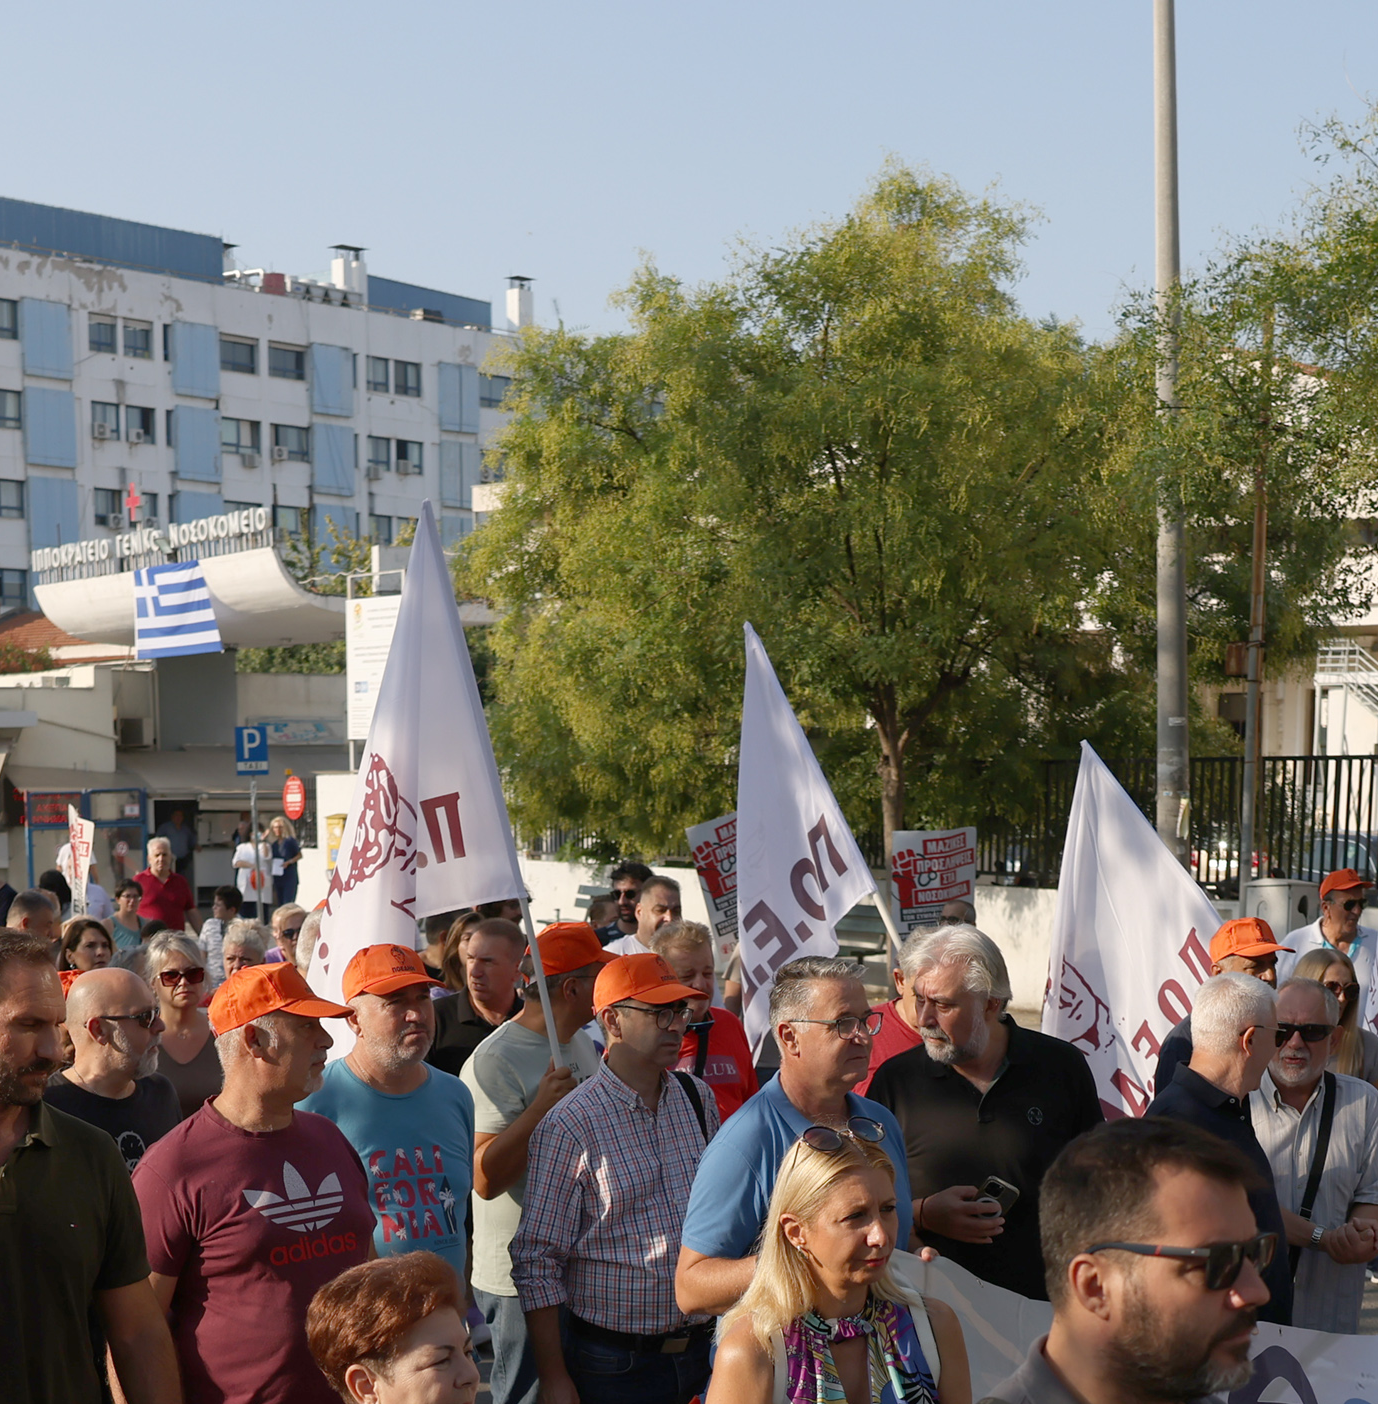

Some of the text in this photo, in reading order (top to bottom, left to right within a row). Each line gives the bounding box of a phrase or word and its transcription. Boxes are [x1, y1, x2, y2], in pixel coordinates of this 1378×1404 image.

[31, 538, 111, 572] ΙΠΠΟΚΡΑΤΕΙΟ
[169, 508, 270, 549] ΝΟΣΟΚΟΜΕΙΟ
[243, 728, 260, 759] P
[926, 835, 966, 854] ΜΑΖΙΚΕΣ
[369, 1145, 444, 1179] CALI
[374, 1178, 440, 1212] FOR
[381, 1209, 444, 1243] NIA
[269, 1232, 357, 1266] adidas
